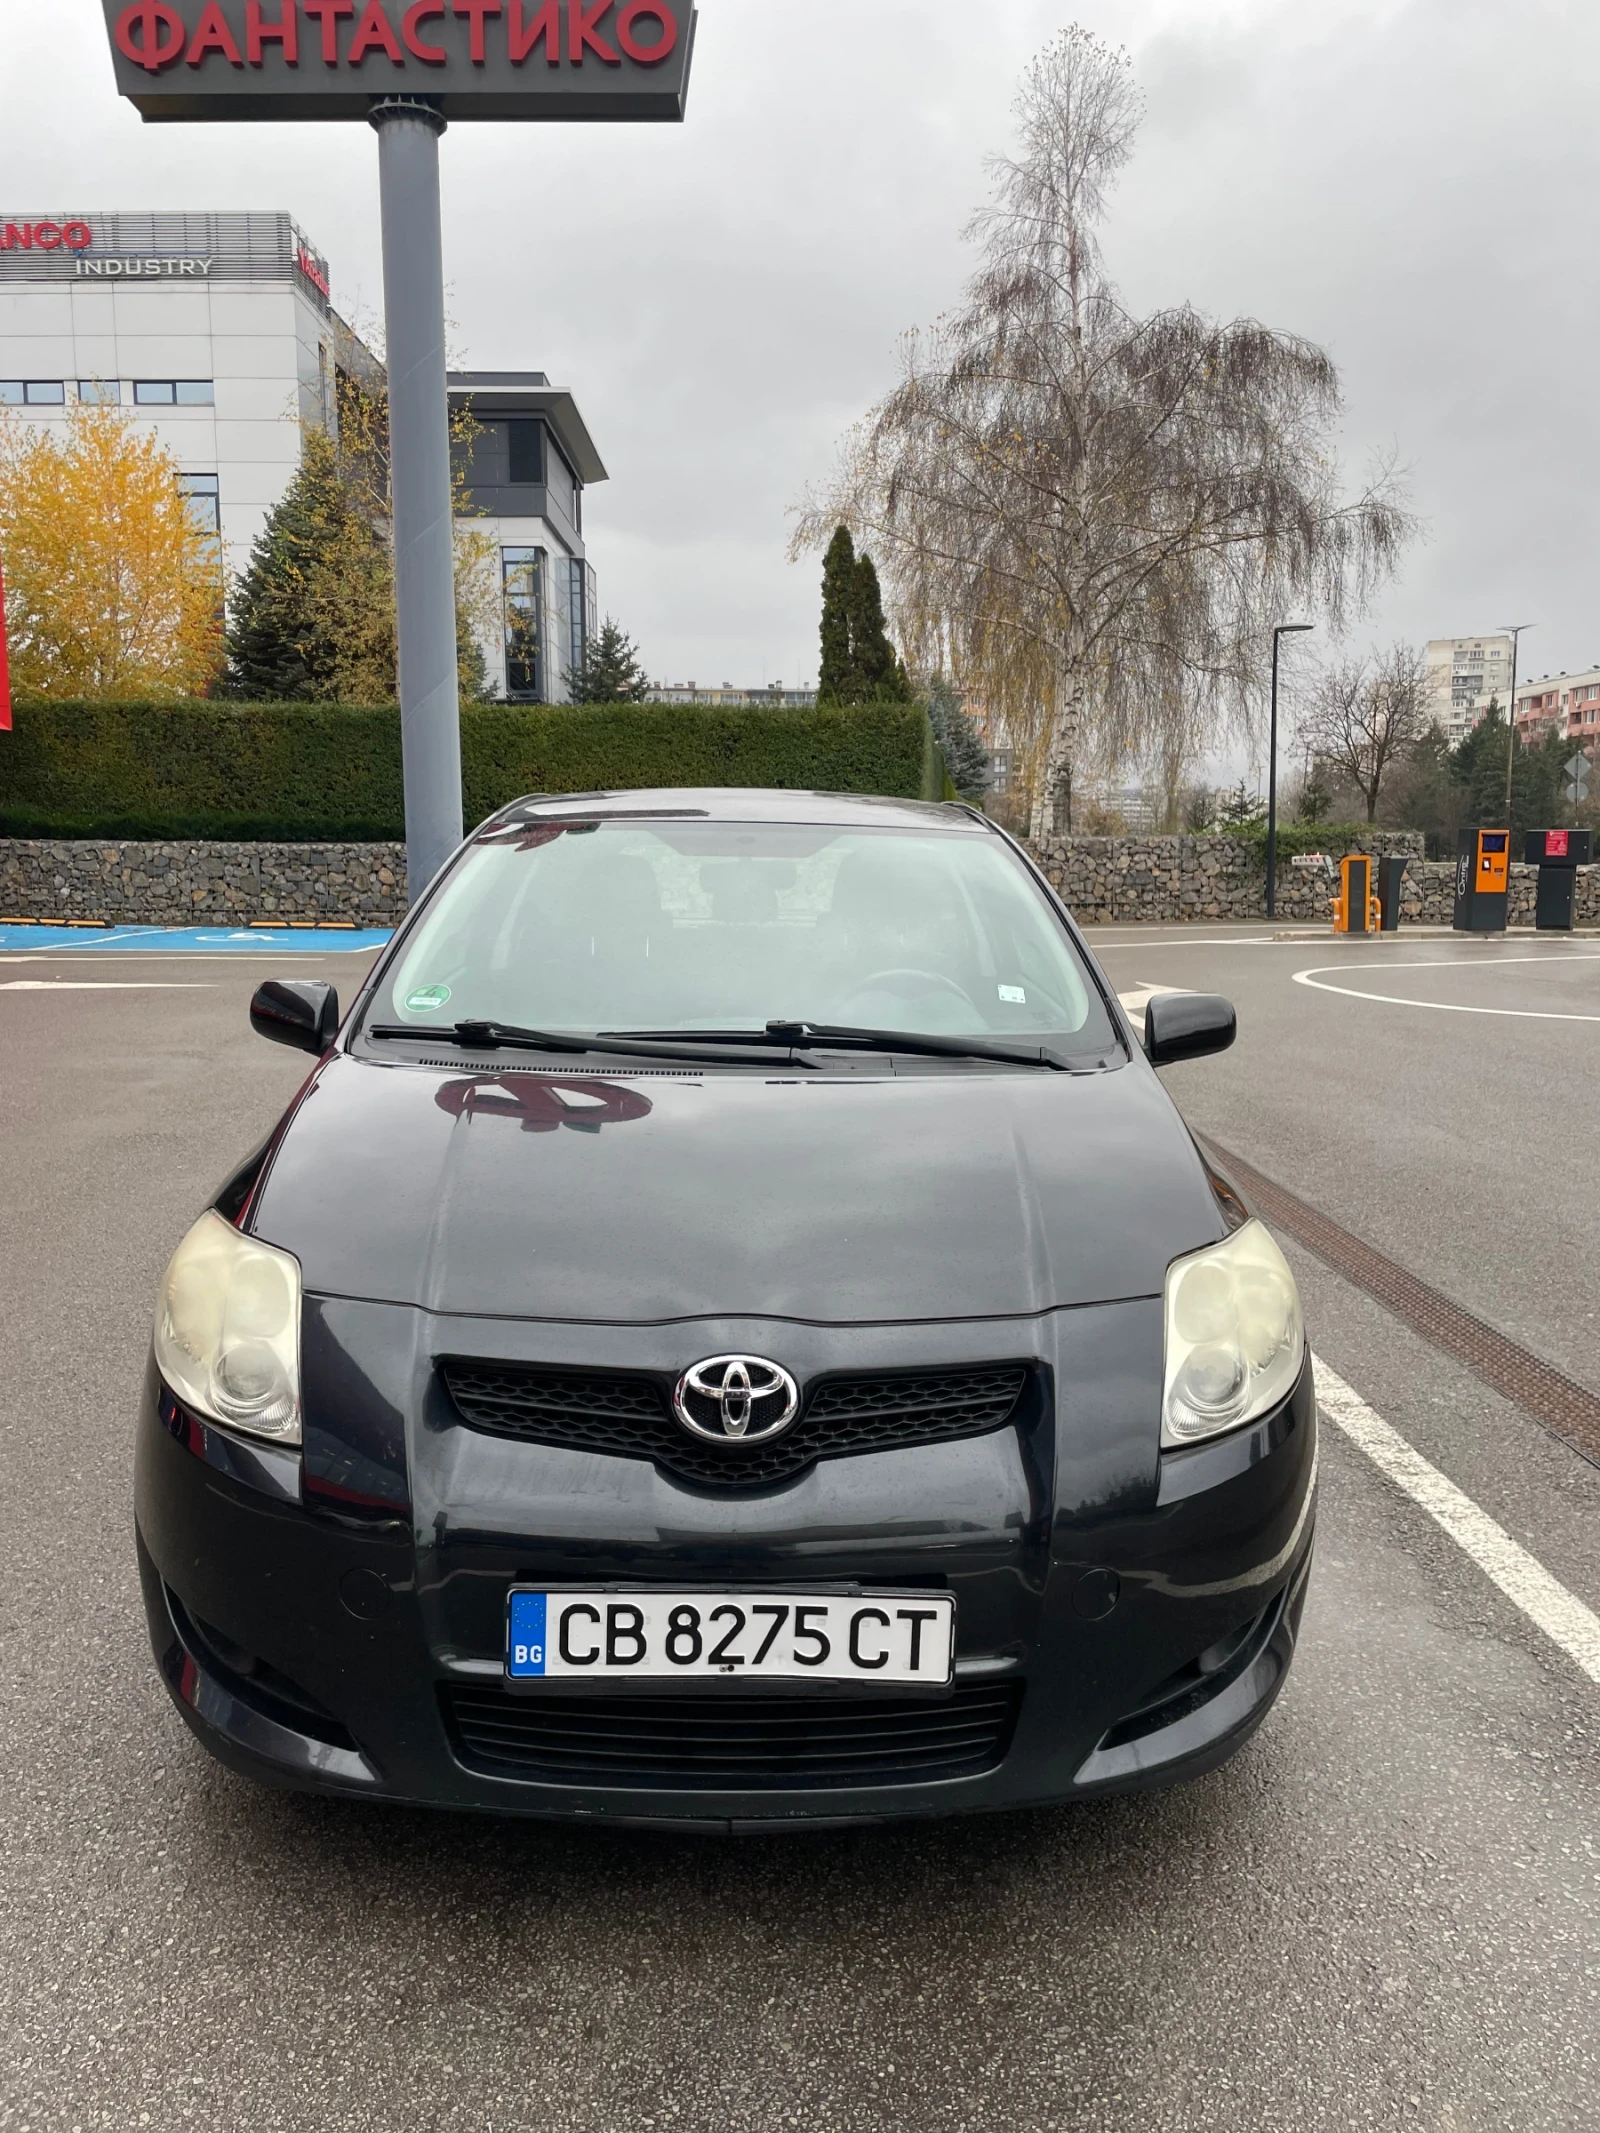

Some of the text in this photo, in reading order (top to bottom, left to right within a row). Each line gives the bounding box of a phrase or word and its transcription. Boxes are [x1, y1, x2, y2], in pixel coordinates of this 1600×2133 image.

[114, 0, 678, 69] ФАНТАСТИКО
[0, 221, 92, 248] NCO
[75, 259, 213, 275] INDUSTRY
[559, 1603, 938, 1671] CB 8275 CT
[514, 1645, 542, 1664] BG
